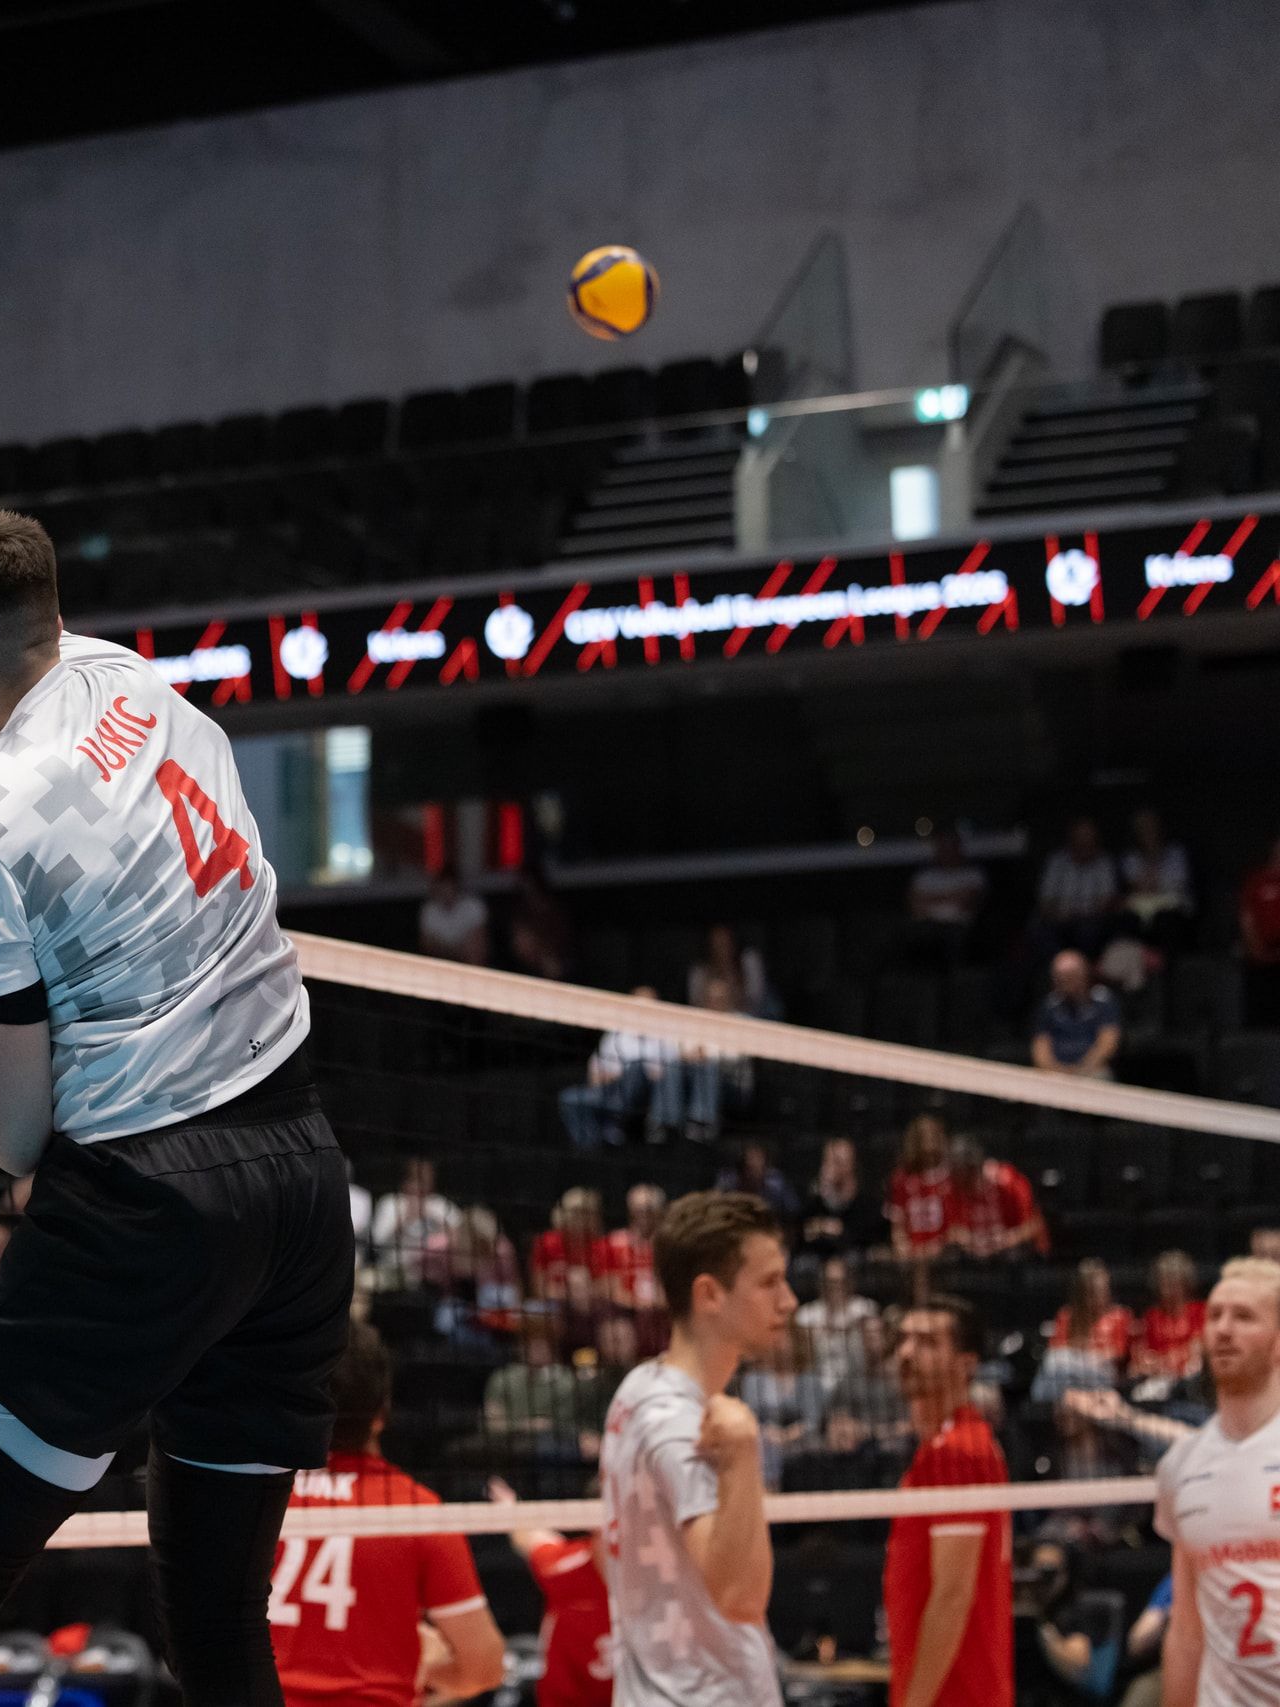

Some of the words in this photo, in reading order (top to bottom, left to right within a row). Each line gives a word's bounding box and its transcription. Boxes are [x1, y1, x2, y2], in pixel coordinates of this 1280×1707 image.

[76, 696, 157, 782] JUKIC
[155, 758, 255, 898] 4
[266, 1535, 357, 1632] 24
[1229, 1579, 1275, 1658] 2
